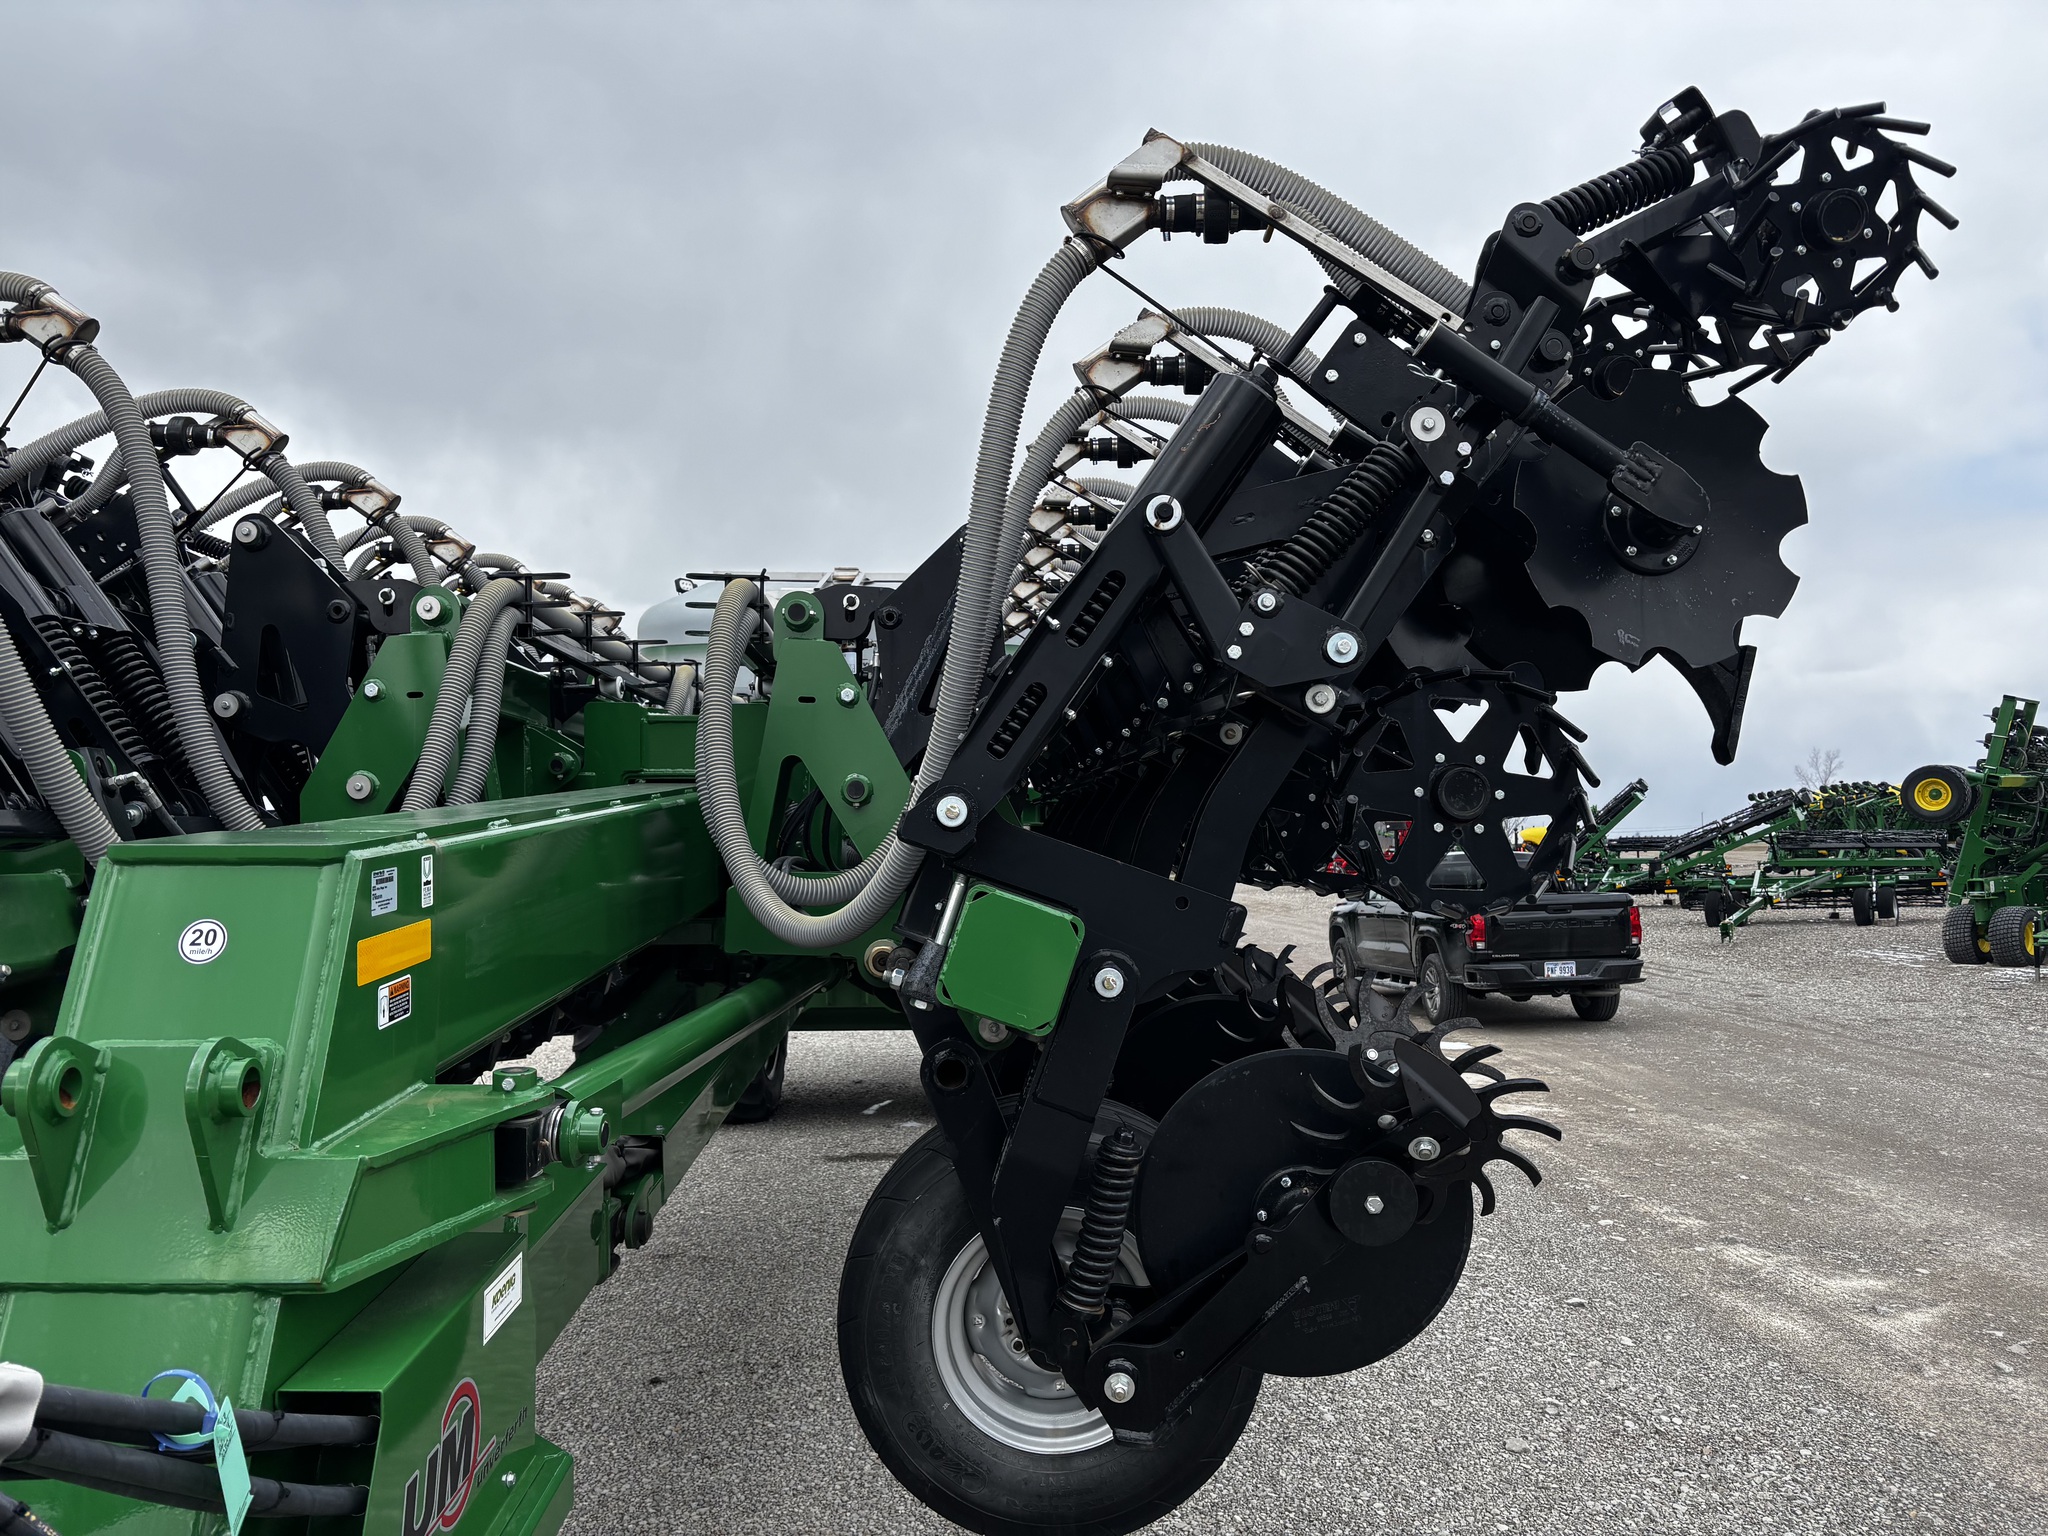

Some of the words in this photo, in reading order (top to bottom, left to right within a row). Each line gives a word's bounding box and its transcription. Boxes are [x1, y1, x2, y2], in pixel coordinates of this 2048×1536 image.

[1503, 918, 1616, 931] CHEVROLET
[189, 928, 217, 947] 20
[189, 947, 213, 955] mile/h
[1558, 965, 1574, 975] 9938
[475, 1405, 528, 1488] unverferth
